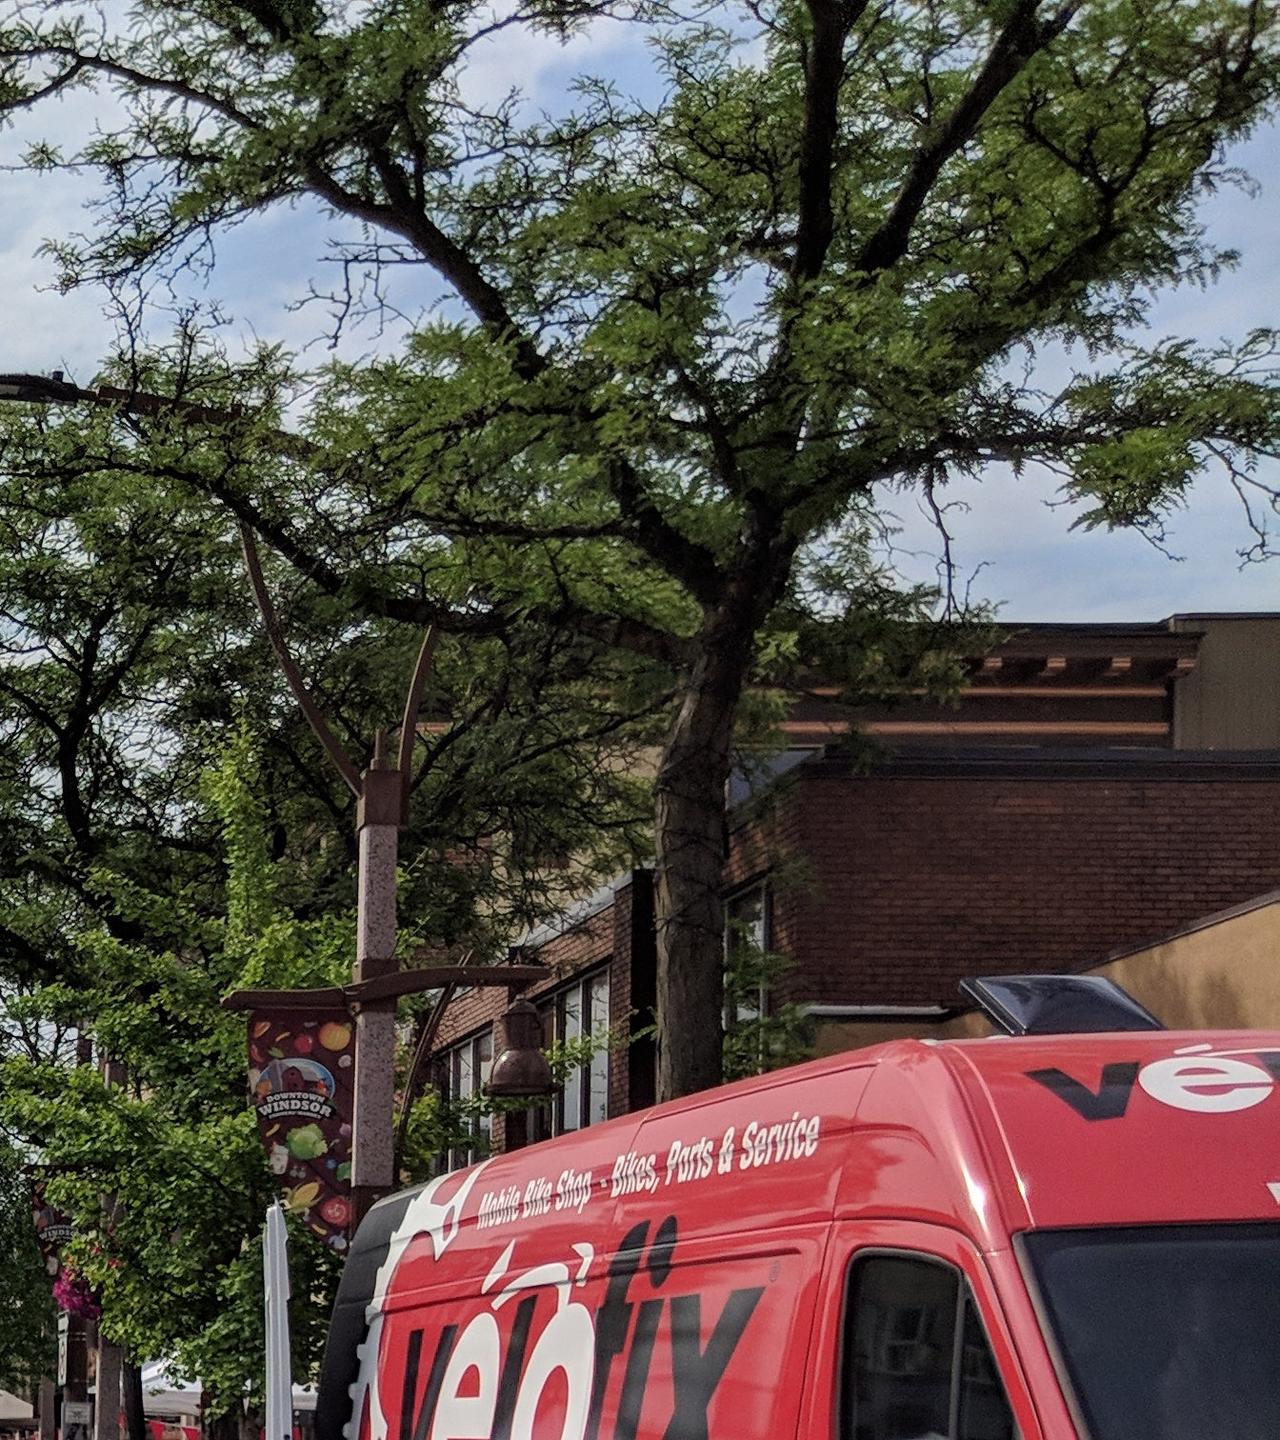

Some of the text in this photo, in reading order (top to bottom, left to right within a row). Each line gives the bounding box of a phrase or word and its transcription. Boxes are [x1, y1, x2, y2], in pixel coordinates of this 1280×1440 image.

[266, 1092, 325, 1103] DOWNTOWN
[258, 1100, 332, 1118] WINDSOR
[476, 1183, 520, 1230] Mobile
[523, 1174, 552, 1217] Bike
[555, 1168, 592, 1214] Shop
[610, 1151, 660, 1198] Bikes,
[665, 1136, 714, 1187] Parts
[717, 1125, 736, 1175] &
[739, 1111, 820, 1170] Service
